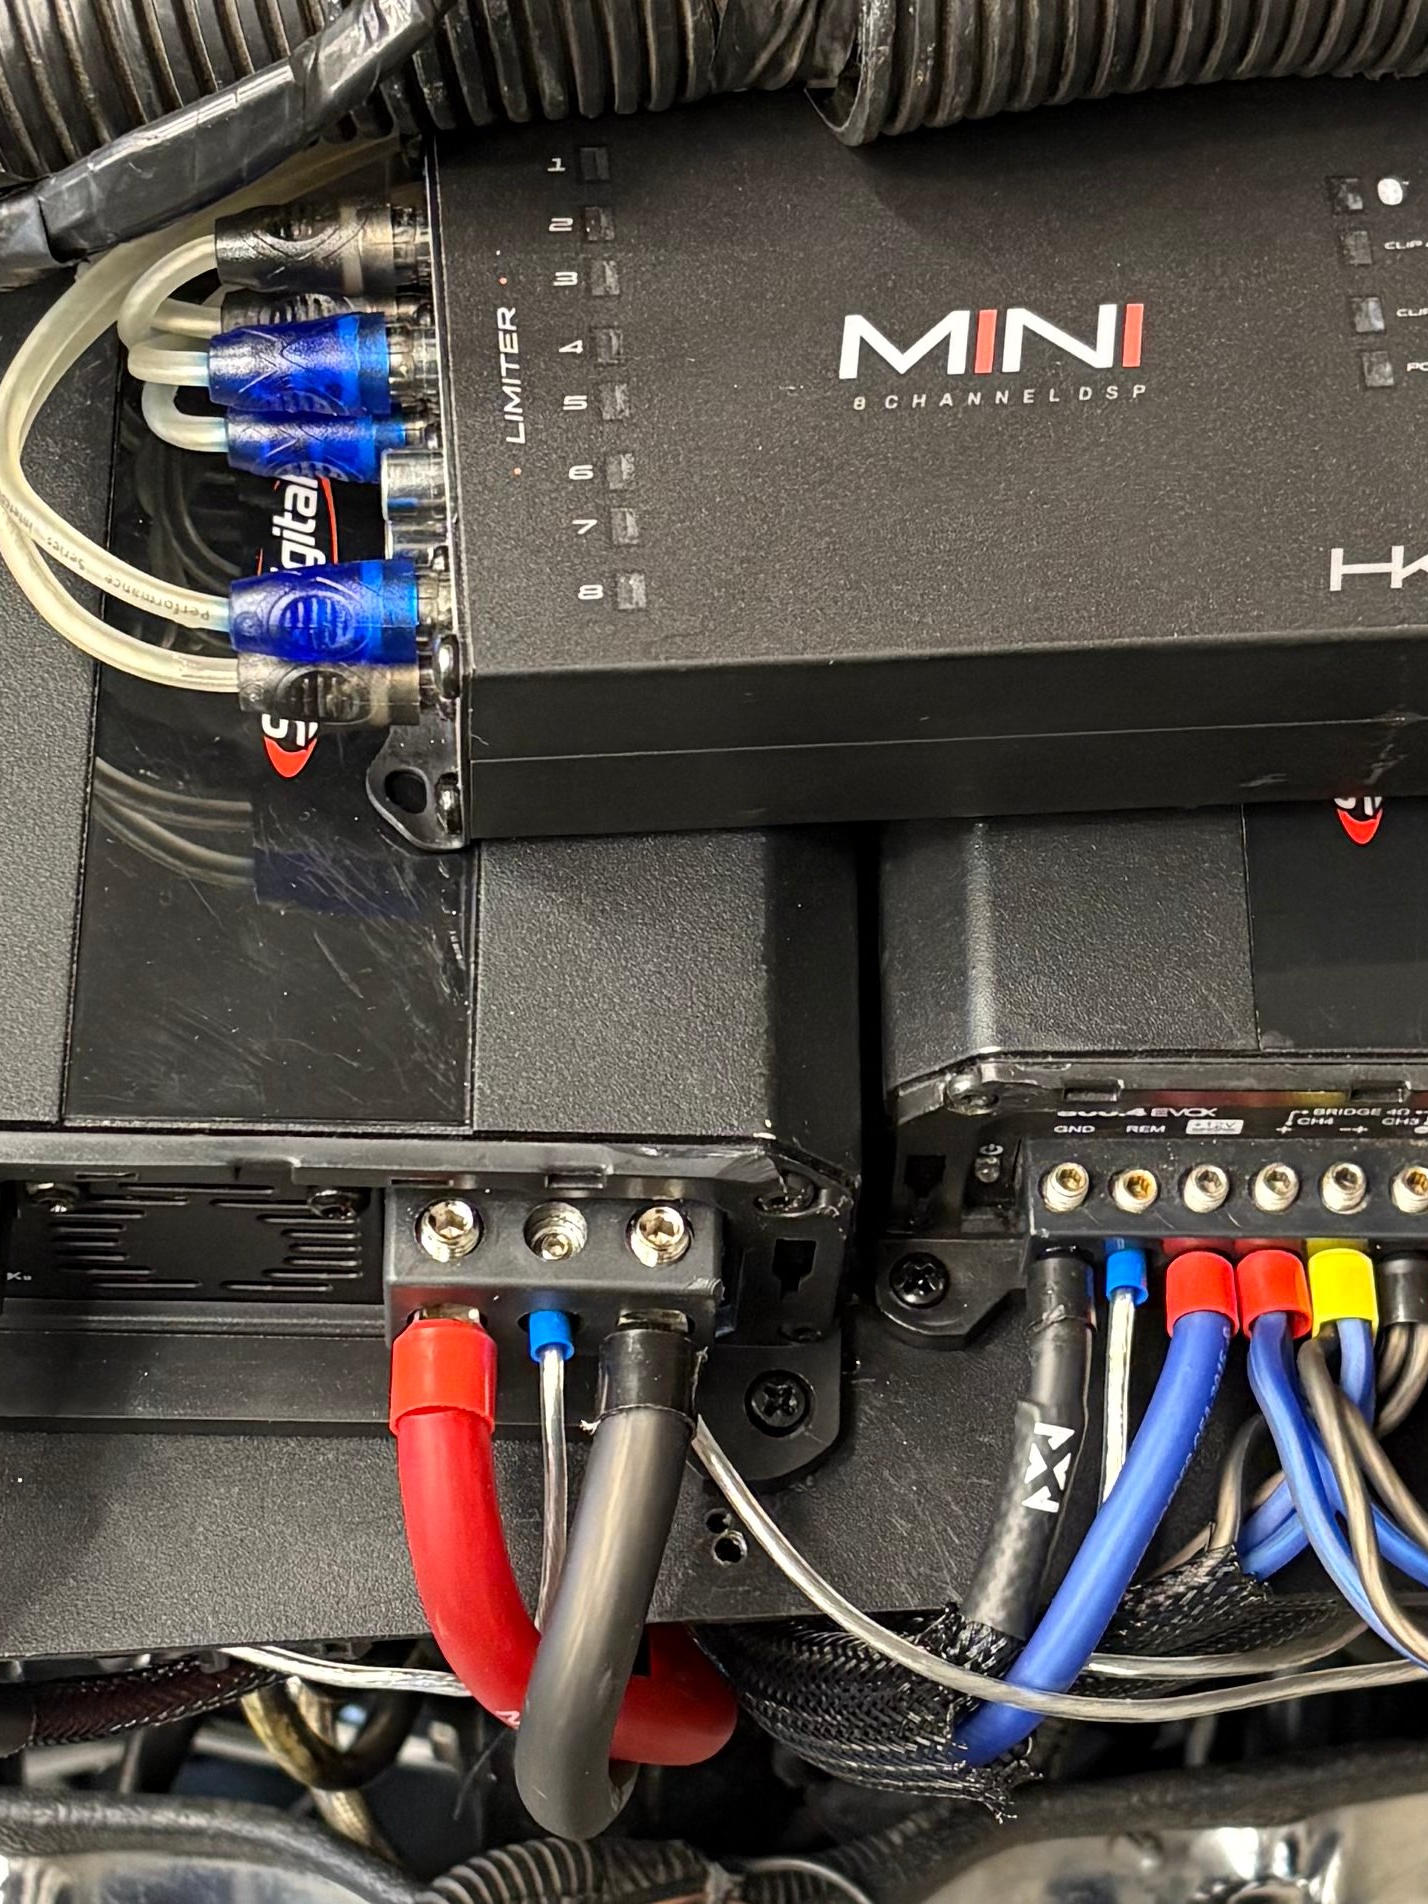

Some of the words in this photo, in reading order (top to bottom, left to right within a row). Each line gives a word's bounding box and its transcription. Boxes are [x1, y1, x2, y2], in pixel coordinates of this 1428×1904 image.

[547, 157, 566, 172] 1
[548, 217, 574, 232] 2
[1384, 239, 1423, 250] CLIP
[553, 271, 578, 286] 3
[558, 339, 584, 354] 4
[838, 303, 1145, 380] MINI
[496, 306, 526, 444] LIMITER
[562, 395, 588, 411] 5
[853, 396, 866, 411] 8
[884, 388, 1061, 410] CHANNEL
[1078, 384, 1147, 402] DSP
[568, 464, 594, 480] 6
[572, 519, 598, 535] 7
[45, 534, 86, 572] Series
[102, 572, 211, 622] Performance
[577, 584, 604, 600] 8
[1150, 1107, 1218, 1117] EVOX
[1313, 1107, 1382, 1117] BRIDGE
[1053, 1124, 1096, 1134] GND
[1125, 1124, 1166, 1134] REM
